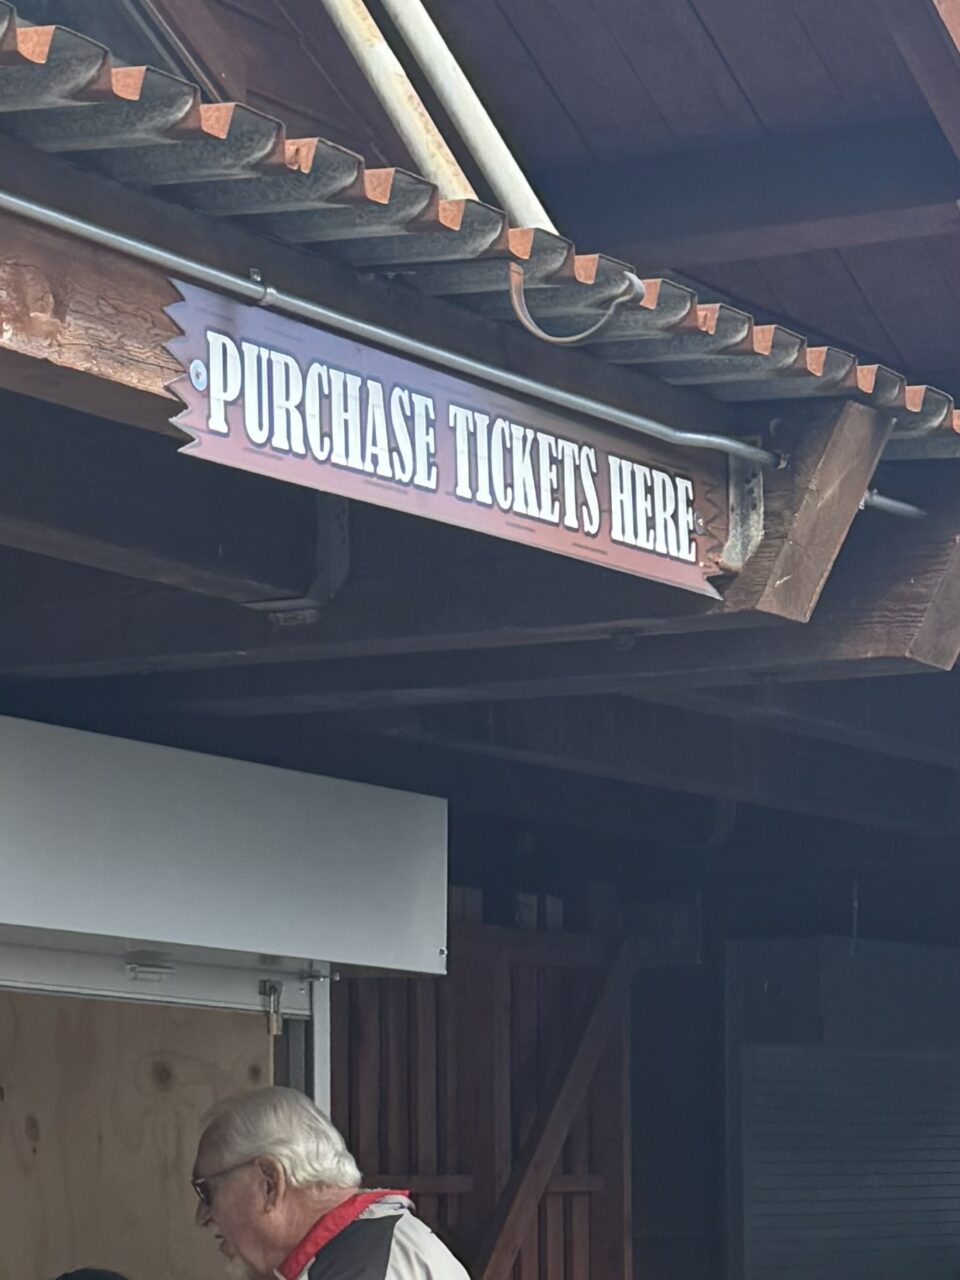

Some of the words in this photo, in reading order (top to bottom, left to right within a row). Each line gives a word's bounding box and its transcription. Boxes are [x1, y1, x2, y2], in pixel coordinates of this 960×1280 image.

[206, 331, 437, 490] PURCHASE
[448, 403, 599, 534] TICKETS
[608, 455, 696, 562] HERE
